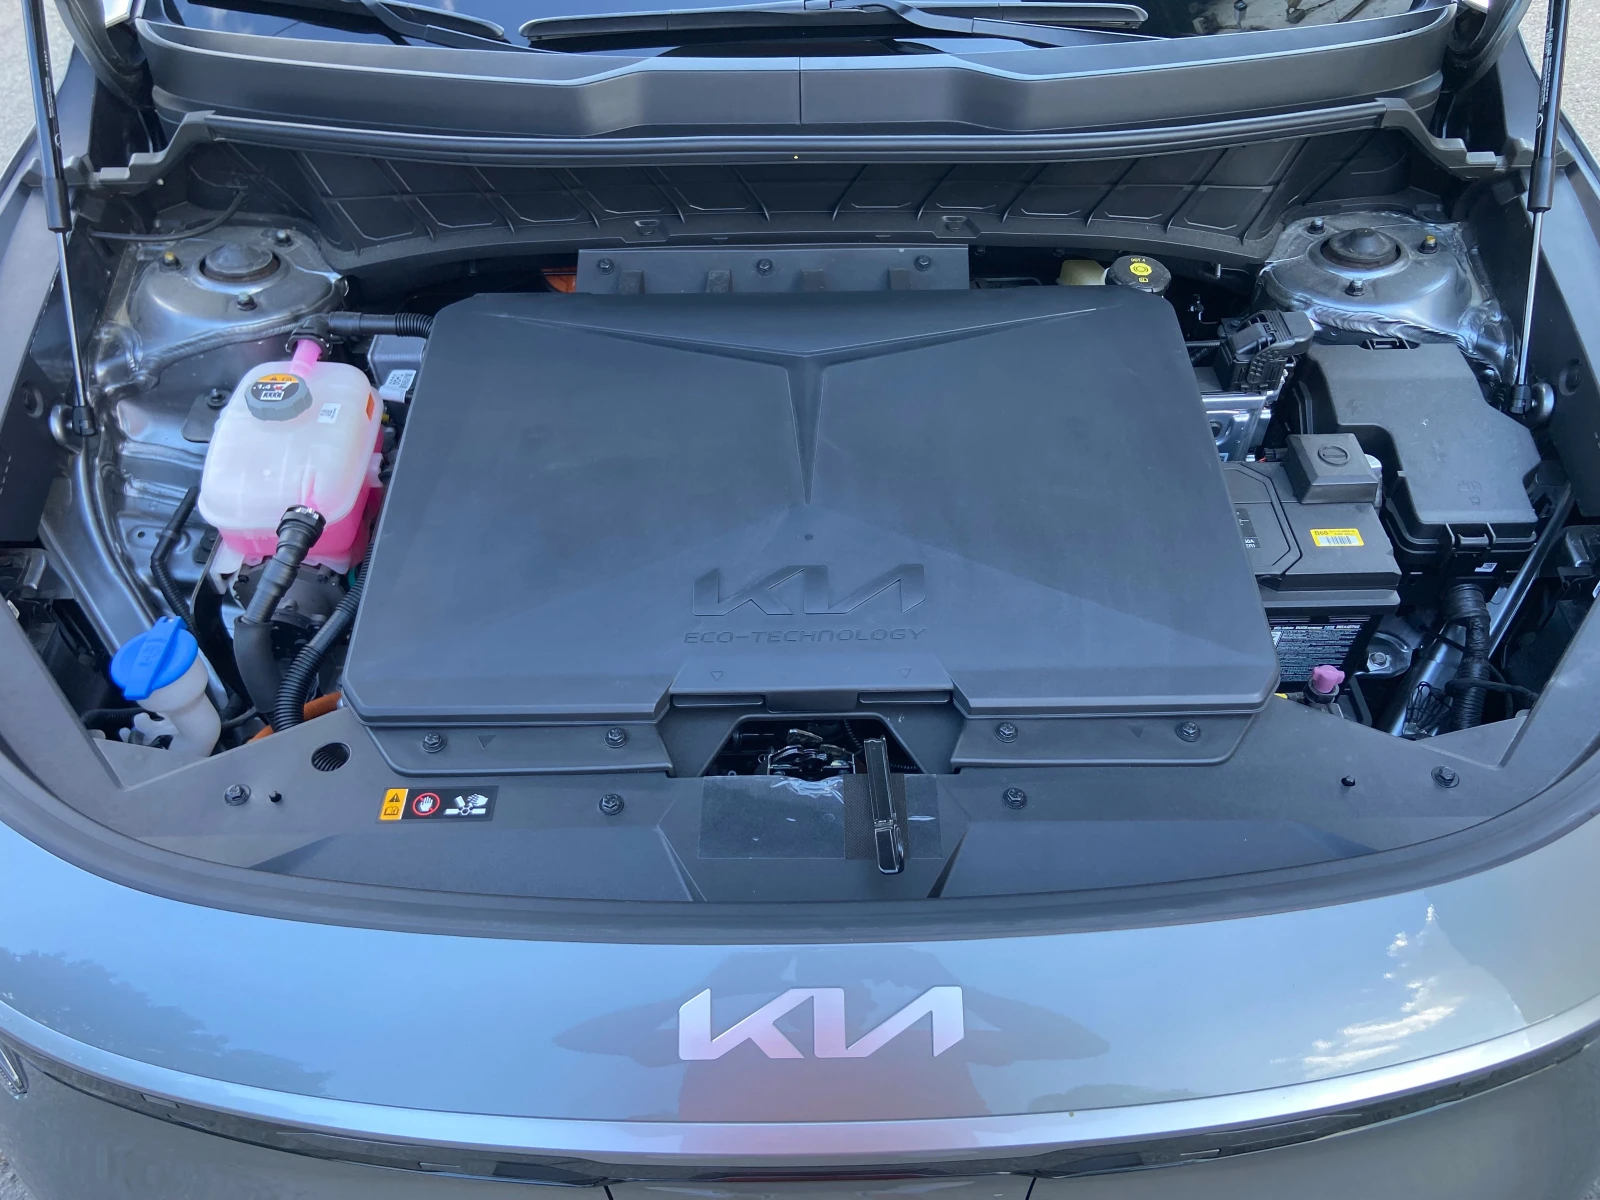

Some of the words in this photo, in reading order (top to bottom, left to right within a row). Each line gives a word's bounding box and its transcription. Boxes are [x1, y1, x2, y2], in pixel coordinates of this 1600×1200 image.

[692, 563, 926, 617] KIA
[683, 627, 926, 644] ECO-TECHNOLOGY
[678, 985, 965, 1061] KIA
